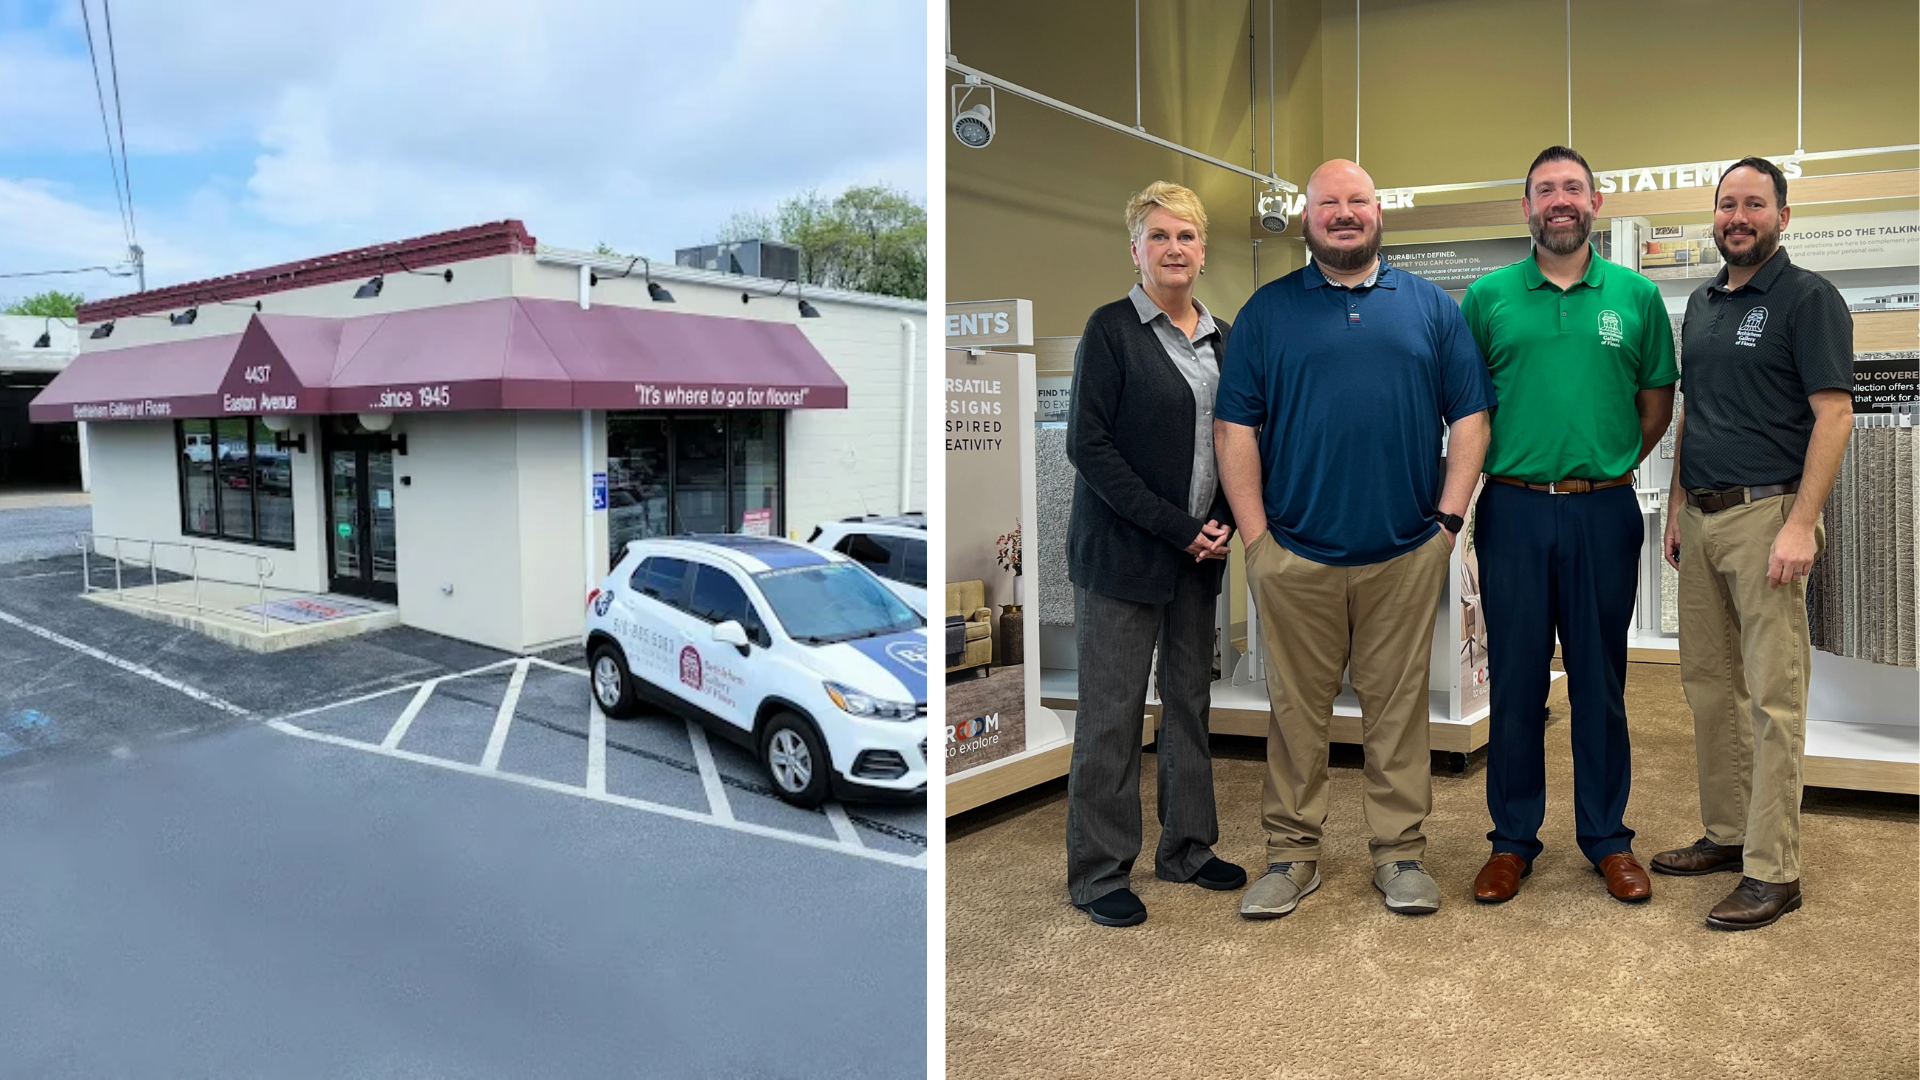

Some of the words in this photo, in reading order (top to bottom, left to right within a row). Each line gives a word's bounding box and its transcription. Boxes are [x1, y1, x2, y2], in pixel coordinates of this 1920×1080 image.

[1793, 230, 1835, 240] FLOORS
[1837, 229, 1853, 238] DO
[1855, 227, 1876, 236] THE
[1878, 224, 1919, 235] TALKIN
[1867, 238, 1905, 246] complement
[1841, 247, 1867, 255] personal
[1388, 253, 1426, 261] DURABILITY
[1445, 258, 1468, 266] COUNT
[245, 365, 271, 383] 4437
[1874, 371, 1919, 381] COVERE
[1888, 382, 1915, 391] offers
[419, 385, 449, 407] 1945
[664, 385, 708, 405] where
[711, 387, 726, 405] to
[727, 389, 744, 408] go
[747, 387, 764, 405] for
[1038, 389, 1059, 398] FIND
[1855, 394, 1872, 403] that
[1874, 393, 1897, 402] work
[1898, 393, 1912, 402] for
[223, 393, 256, 412] Easton
[260, 392, 297, 411] Avenue
[1038, 400, 1051, 409] TO
[109, 402, 135, 419] Gallery
[145, 399, 171, 416] Floors
[946, 420, 1002, 433] SPIRED
[946, 438, 1002, 451] EATIVITY
[959, 734, 999, 754] explore
